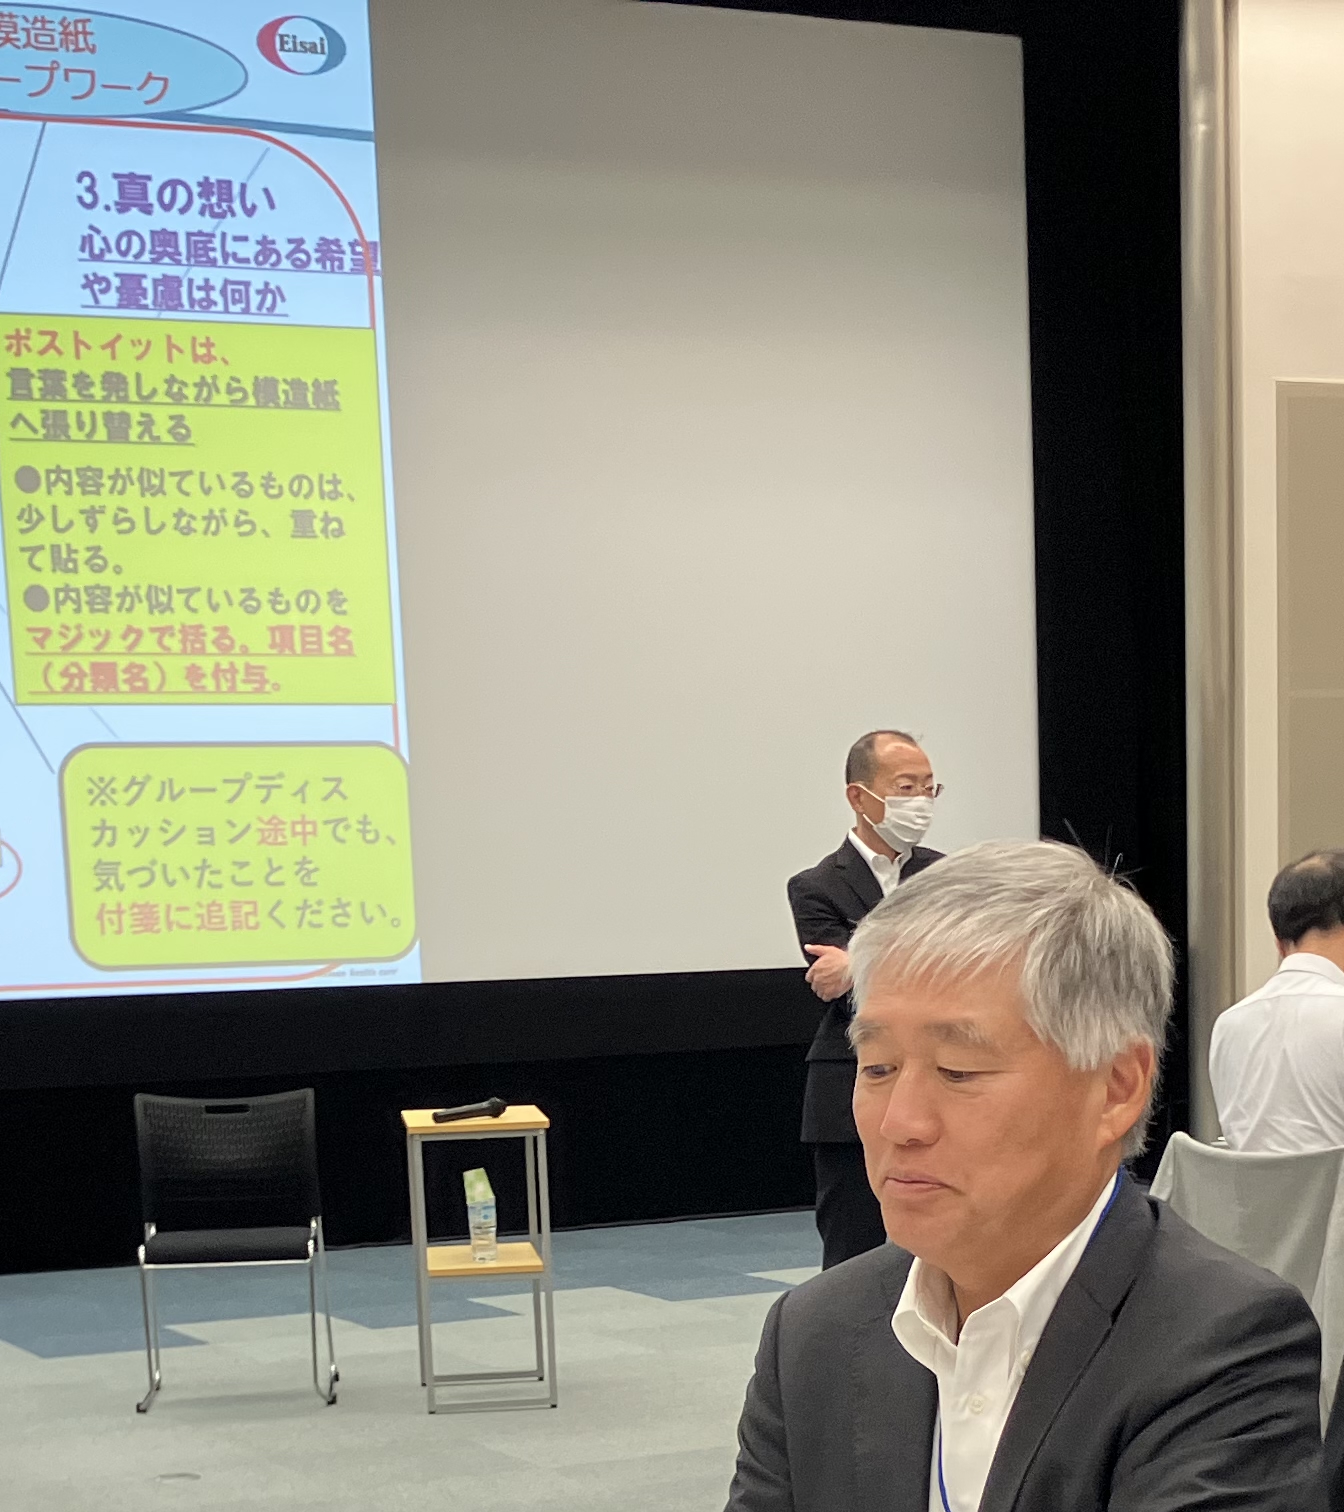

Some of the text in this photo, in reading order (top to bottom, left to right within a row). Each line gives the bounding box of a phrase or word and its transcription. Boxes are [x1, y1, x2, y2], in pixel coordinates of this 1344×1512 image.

[277, 33, 327, 56] Eisai
[75, 170, 277, 220] 3.真の想い
[78, 223, 382, 277] 心の奥底にある希望
[81, 272, 289, 317] や憂慮は何か
[4, 329, 233, 368] ポストイットは、
[6, 367, 342, 410] 言葉を発しながら模造紙
[9, 409, 195, 446] へ張り替える
[16, 503, 346, 541] 少しずらしながら、重ね
[18, 543, 124, 576] て貼る。
[25, 623, 355, 658] マジックで括る。項目名
[89, 812, 399, 848] カッション途中でも、
[93, 856, 321, 893] 気づいたことを
[96, 899, 404, 936] 付箋に追記ください。
